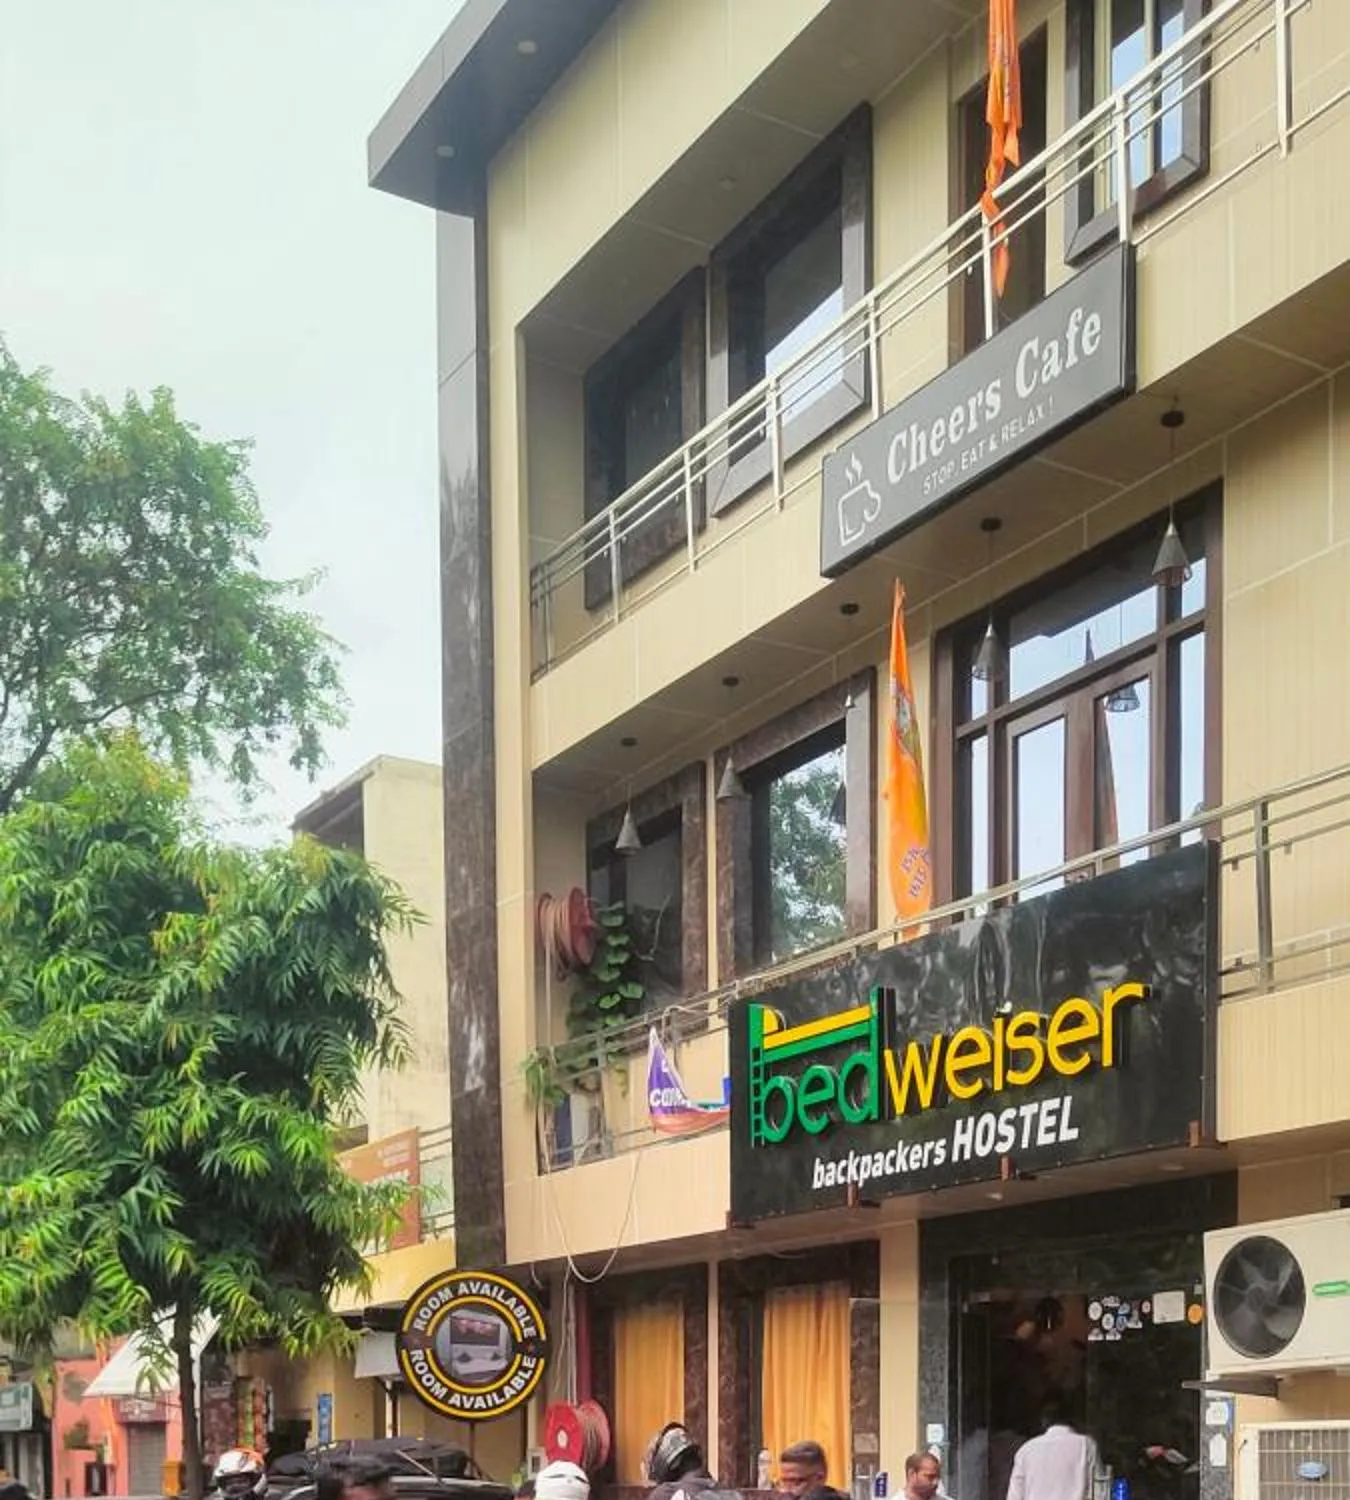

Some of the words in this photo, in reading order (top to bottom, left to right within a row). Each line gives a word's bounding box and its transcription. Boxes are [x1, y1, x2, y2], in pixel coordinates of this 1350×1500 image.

[887, 376, 1001, 484] Cheers
[1014, 307, 1101, 398] Cafe
[961, 440, 986, 470] EAT
[1001, 404, 1044, 444] RELAX
[812, 1138, 947, 1189] backpackers
[952, 1095, 1079, 1163] HOSTEL
[413, 1287, 454, 1331] ROOM
[457, 1281, 537, 1338] AVAILABLE
[410, 1349, 449, 1399] ROOM
[448, 1355, 537, 1409] AVAILABLE
